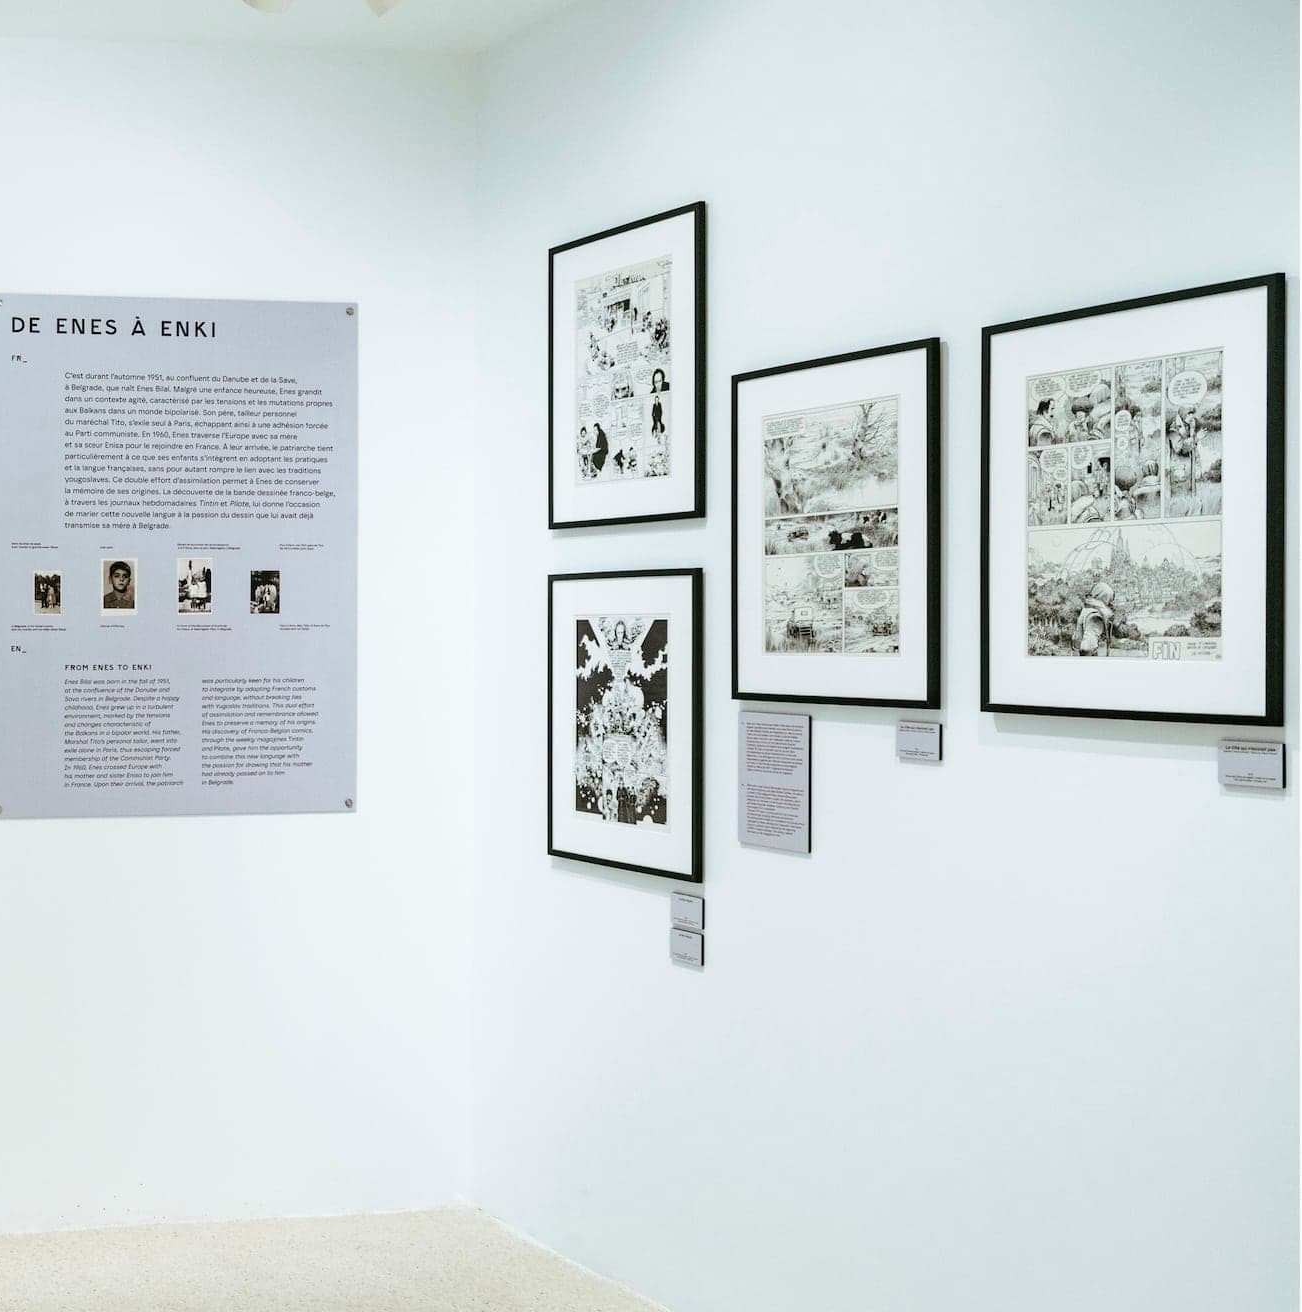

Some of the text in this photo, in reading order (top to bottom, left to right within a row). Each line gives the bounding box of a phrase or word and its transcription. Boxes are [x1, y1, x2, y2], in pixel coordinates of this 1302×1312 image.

[11, 316, 216, 338] DE ENES À ENKI
[148, 374, 164, 382] 1951,
[278, 376, 297, 385] Save,
[71, 384, 104, 393] Belgrade,
[244, 387, 278, 396] heureuse,
[298, 388, 322, 397] grandit
[128, 396, 148, 405] agité,
[262, 410, 297, 419] personnel
[111, 419, 126, 427] Tito,
[174, 420, 192, 428] Paris,
[153, 431, 170, 439] 1960,
[250, 455, 281, 464] adoptant
[295, 455, 328, 464] pratiques
[222, 477, 248, 486] permet
[290, 489, 335, 498] franco-belge,
[110, 499, 140, 508] journaux
[230, 500, 250, 508] Pilote,
